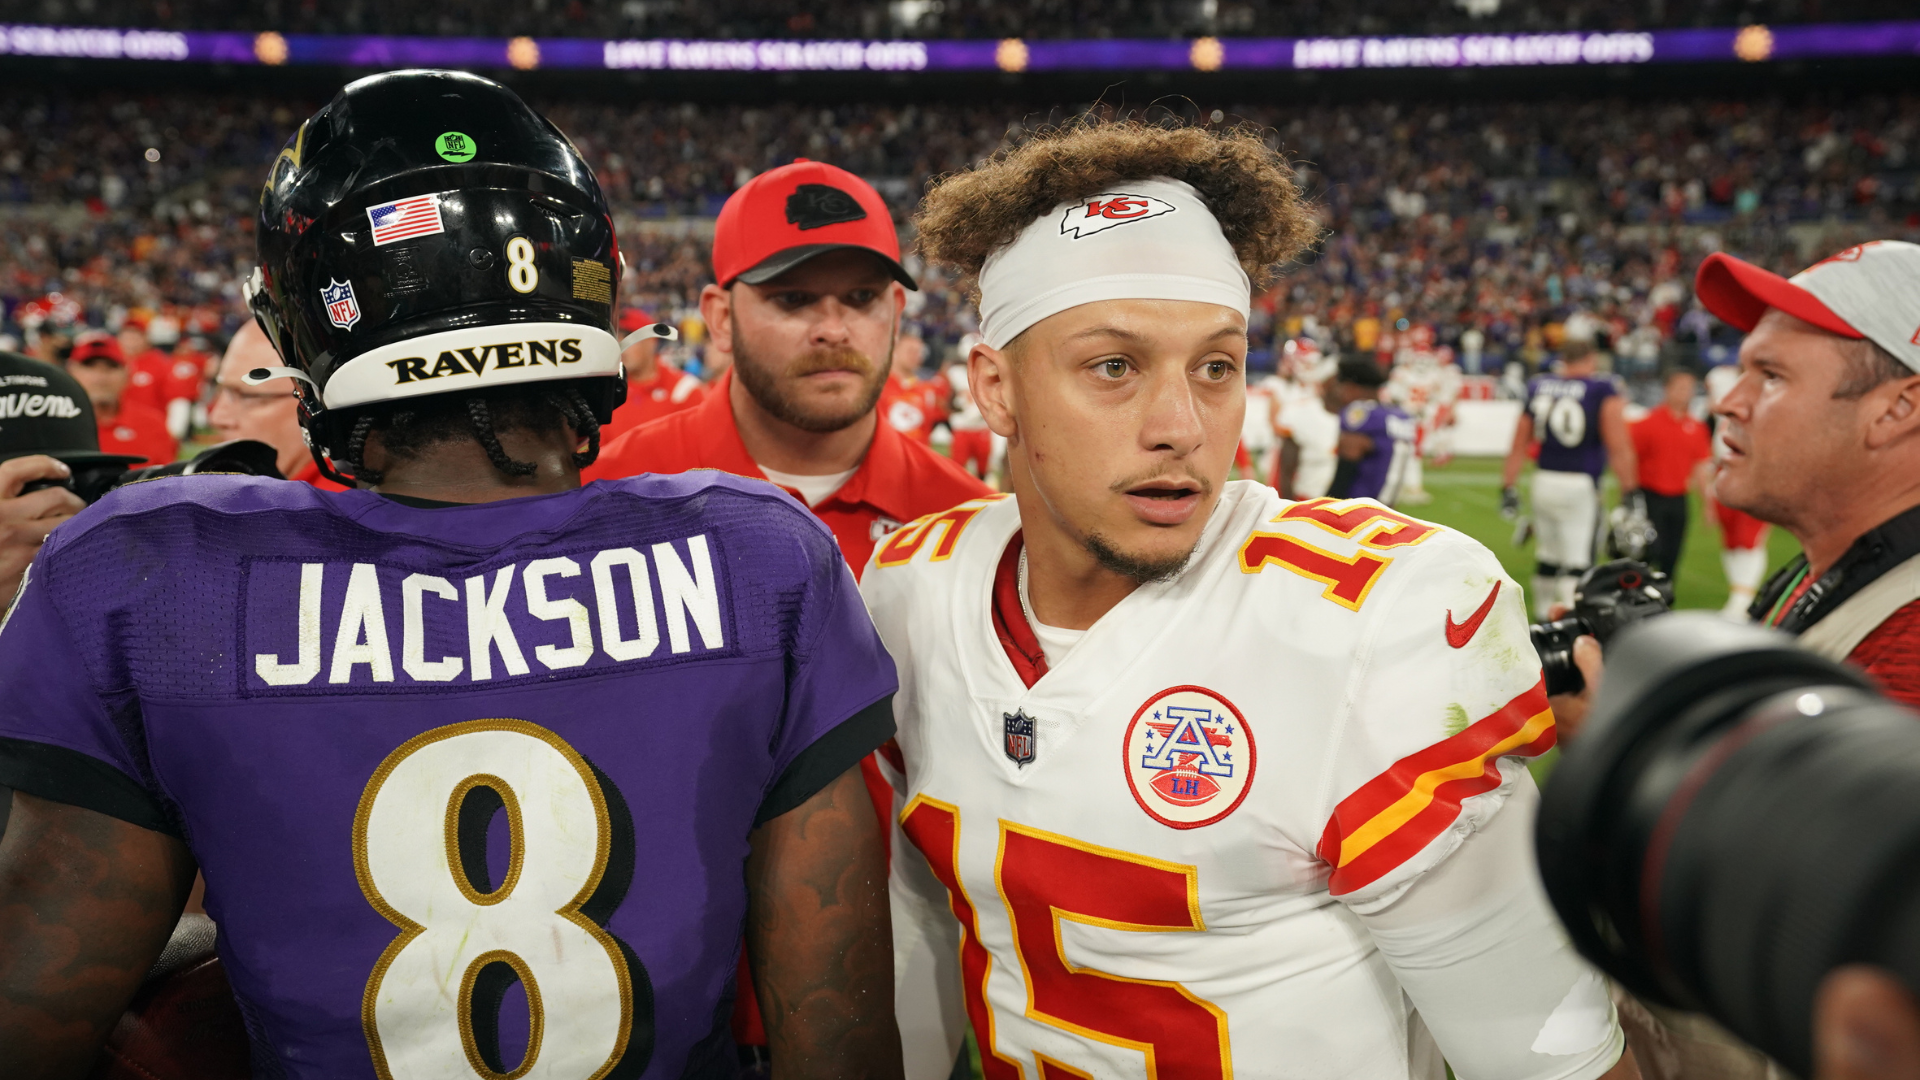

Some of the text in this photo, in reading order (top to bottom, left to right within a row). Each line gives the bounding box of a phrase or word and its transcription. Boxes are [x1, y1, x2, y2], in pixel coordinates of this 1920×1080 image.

[1085, 197, 1149, 219] KC
[506, 235, 540, 294] 8
[330, 300, 356, 322] NFL
[385, 339, 582, 385] RAVENS
[1238, 496, 1445, 612] 15
[256, 534, 724, 686] JACKSON
[1007, 734, 1030, 758] NFL
[1142, 706, 1233, 777] A
[1171, 778, 1199, 796] LH
[352, 718, 636, 1080] 8
[897, 793, 1231, 1080] 15
